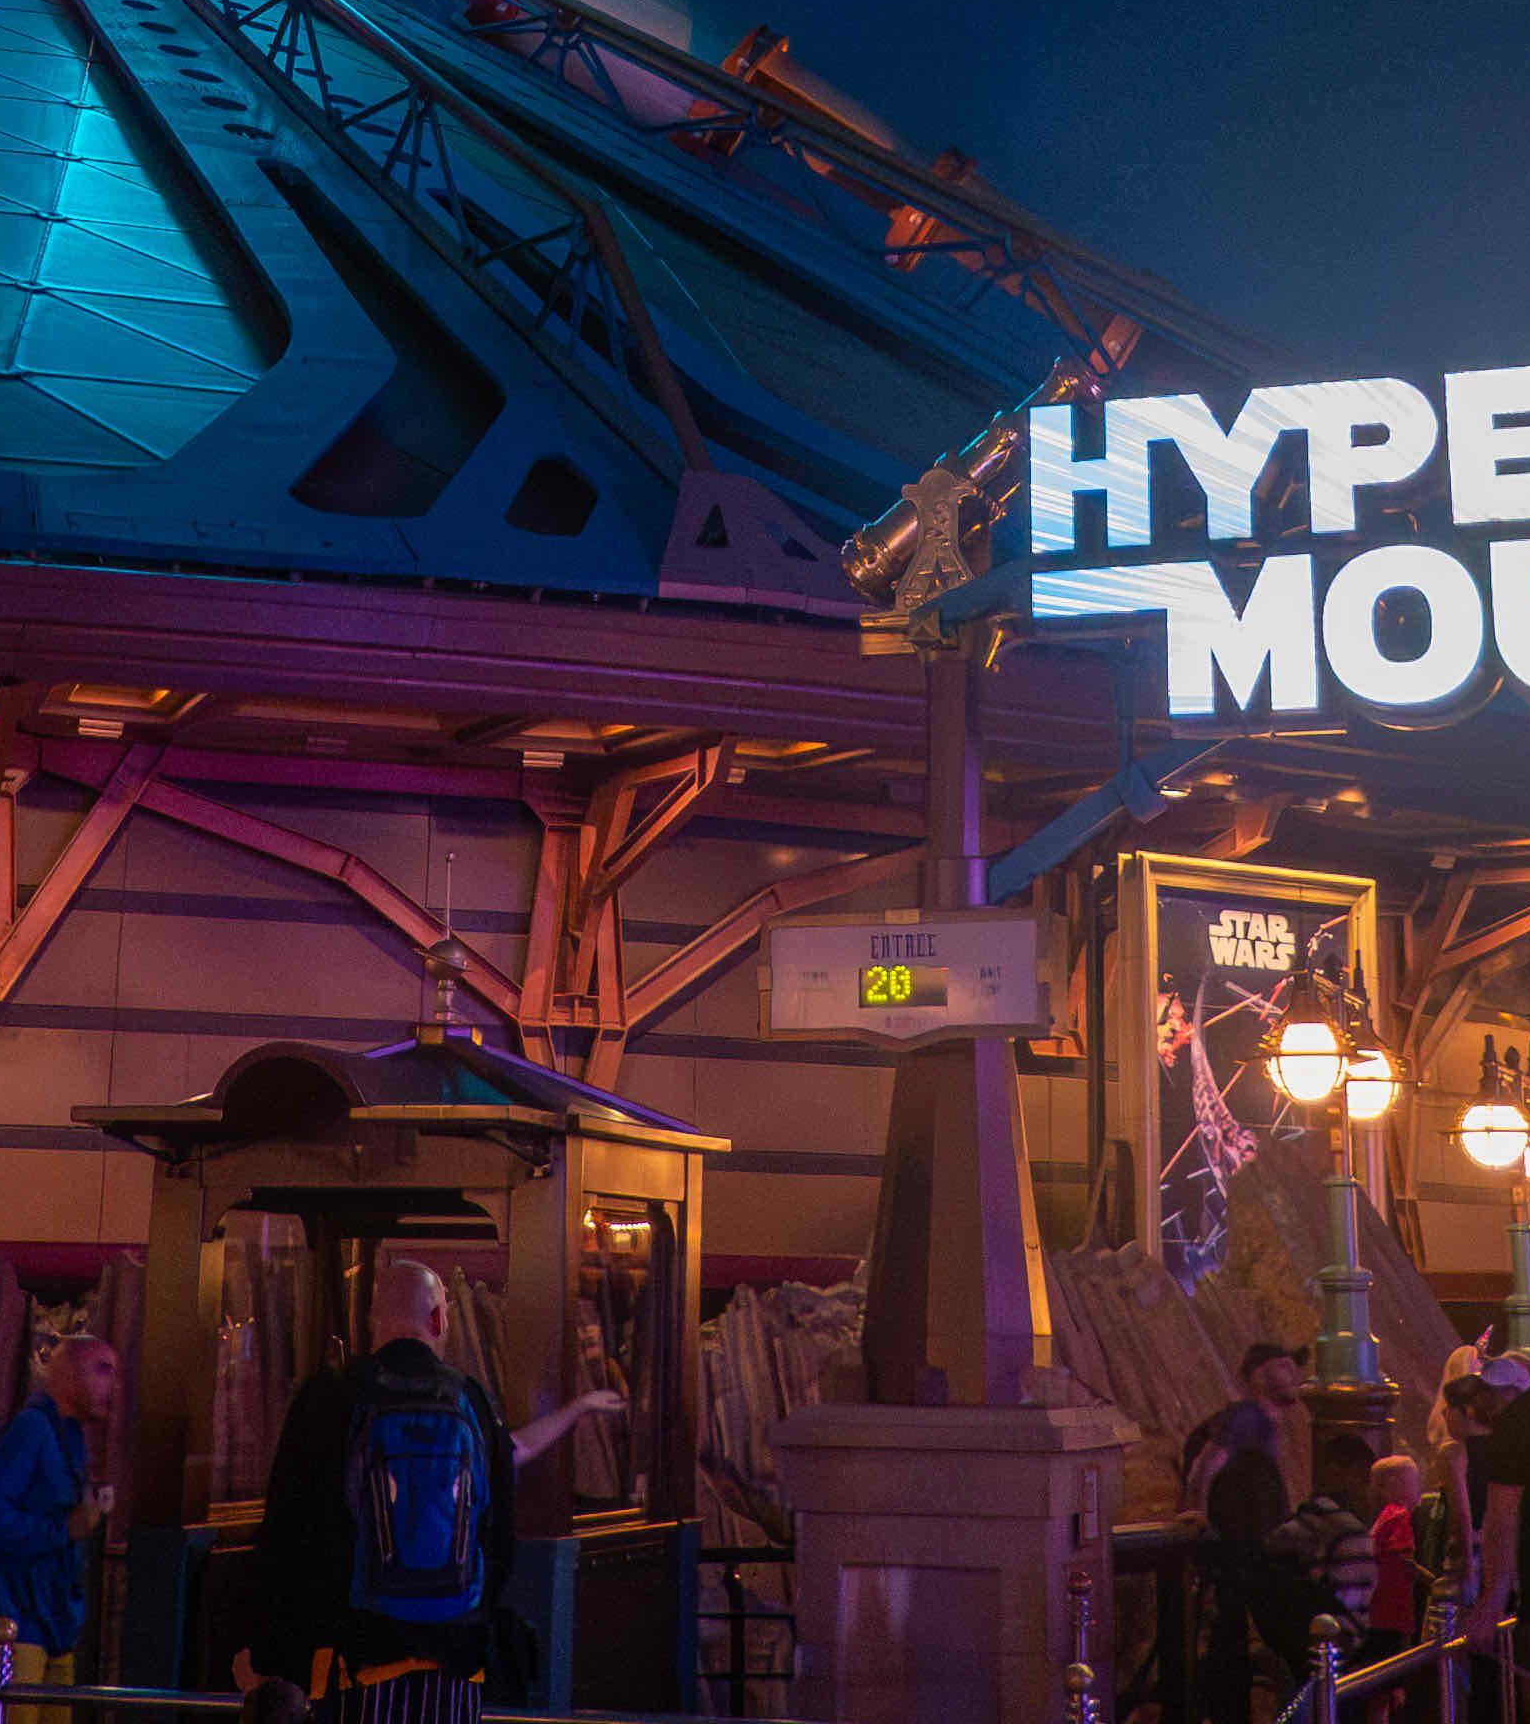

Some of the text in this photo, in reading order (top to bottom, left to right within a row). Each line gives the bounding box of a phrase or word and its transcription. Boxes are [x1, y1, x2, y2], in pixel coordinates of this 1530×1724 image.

[1209, 909, 1295, 943] STAR
[1209, 936, 1295, 971] WARS
[867, 966, 911, 1002] 20
